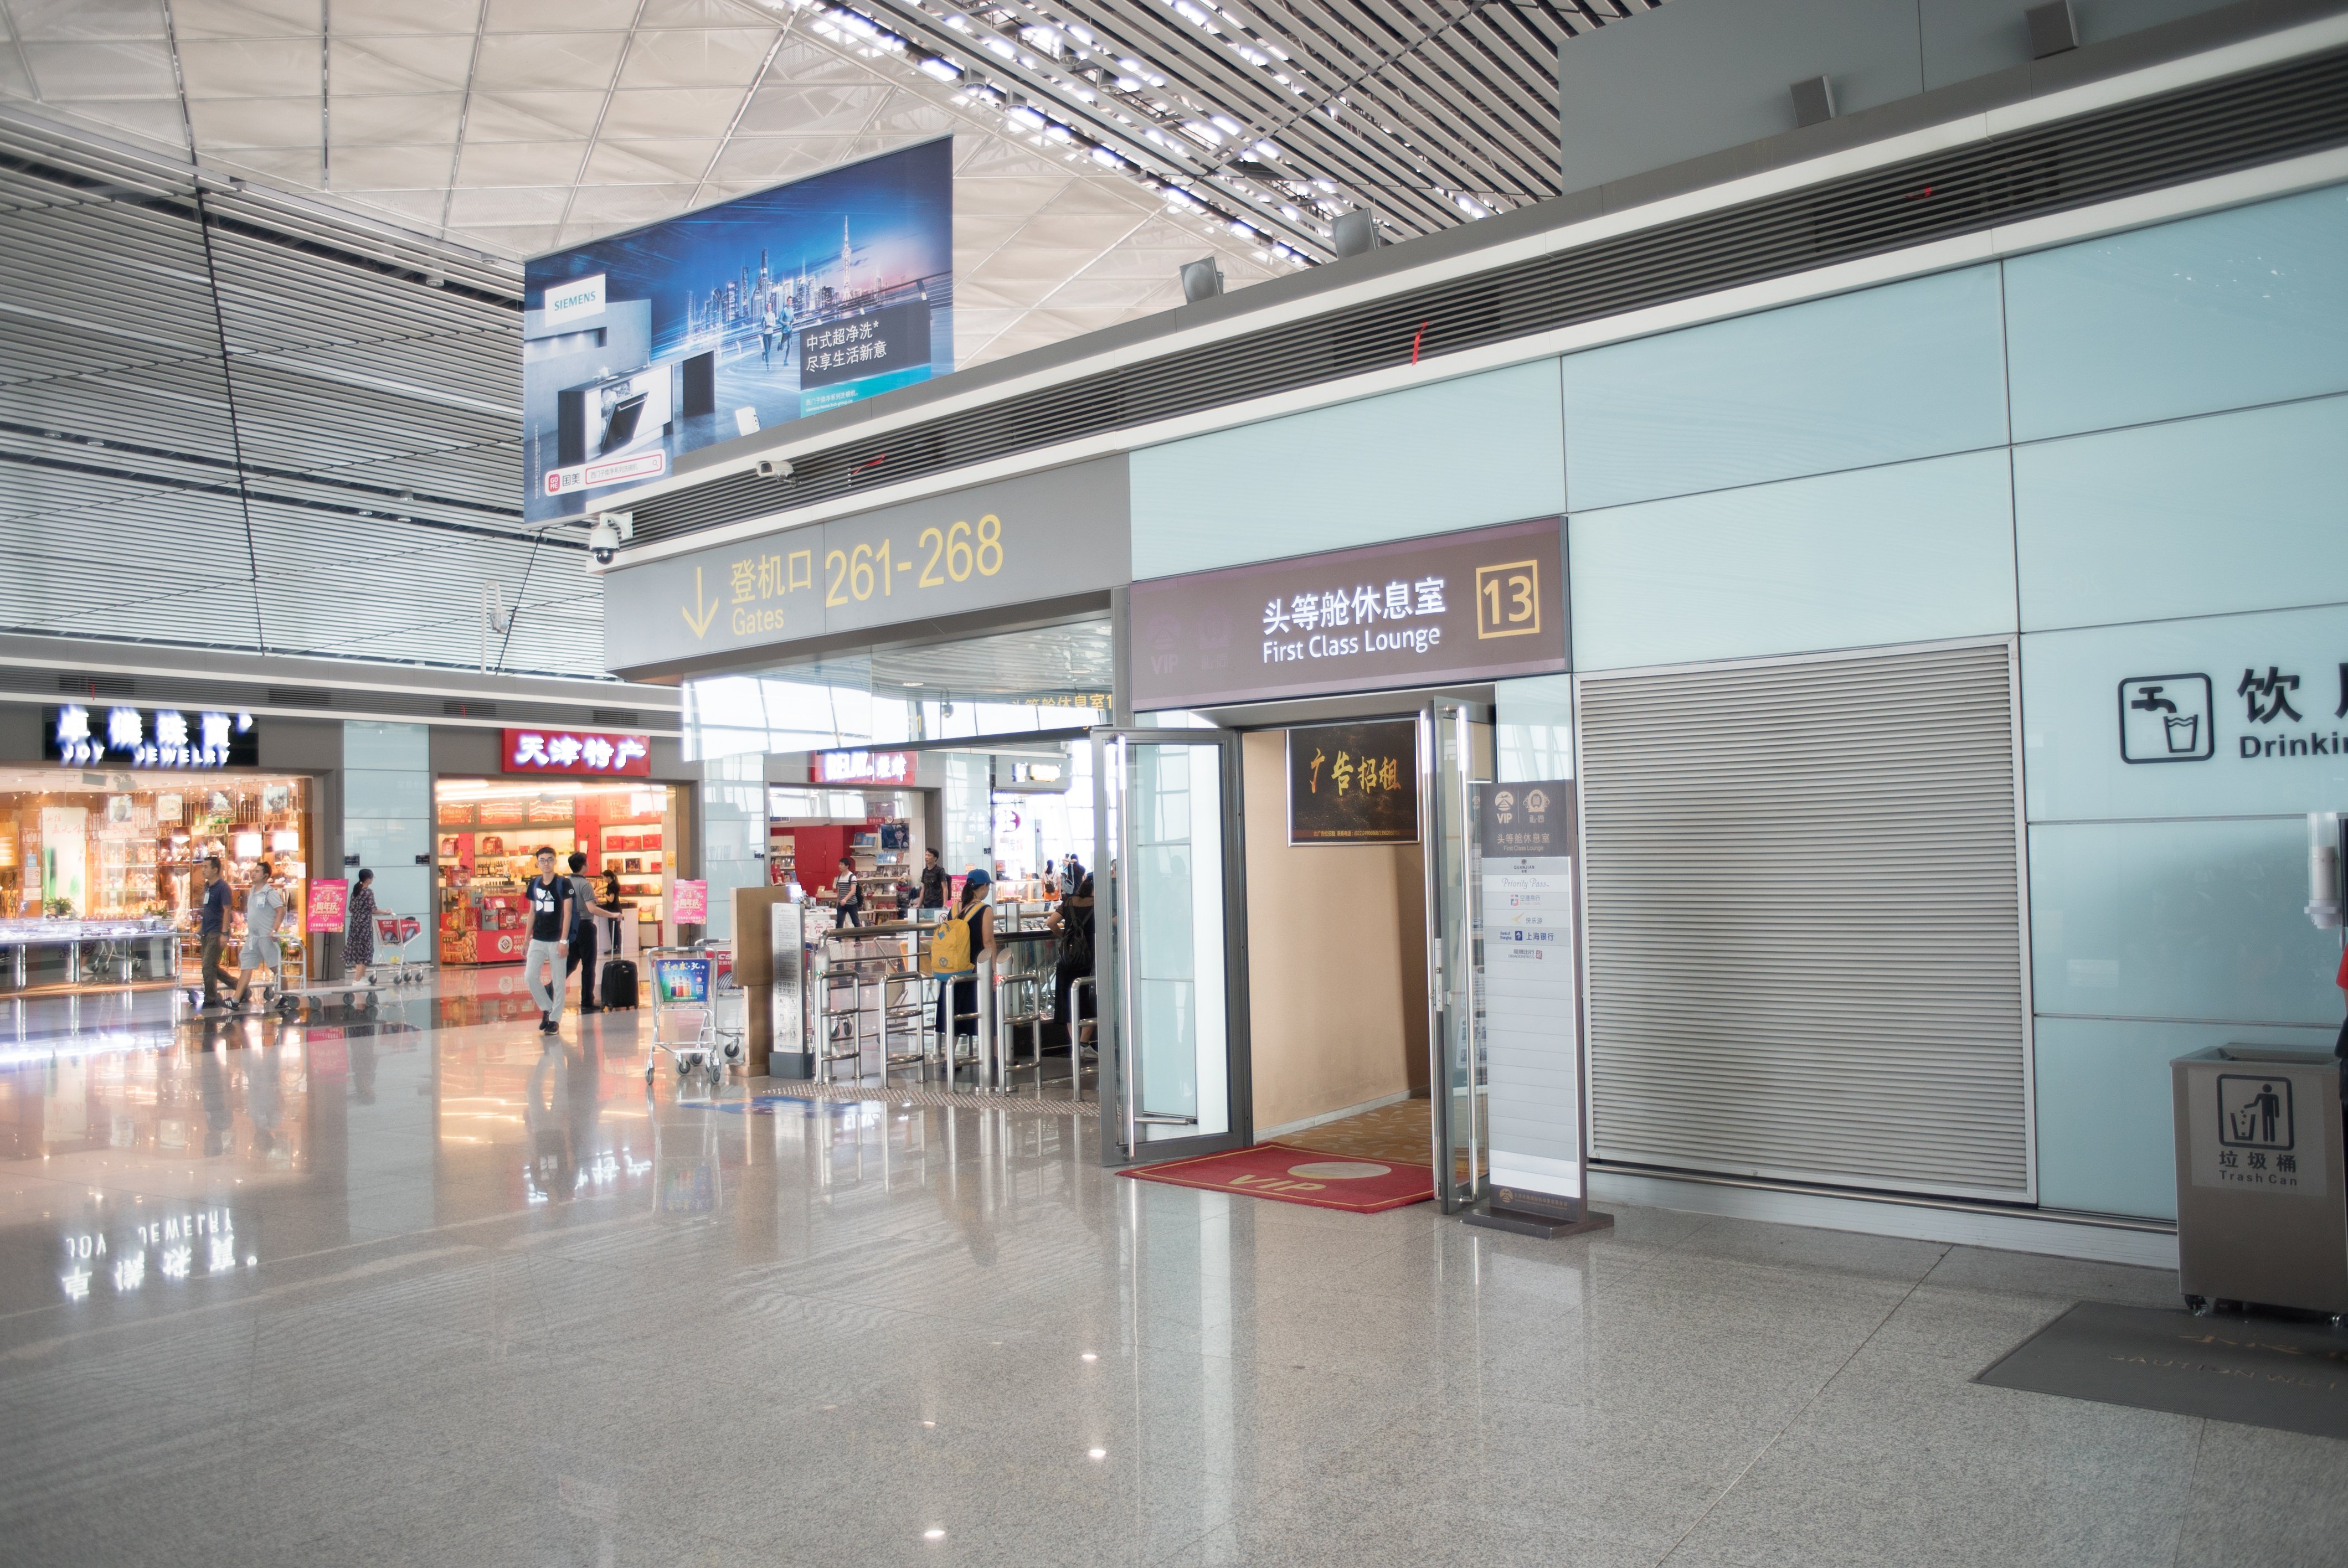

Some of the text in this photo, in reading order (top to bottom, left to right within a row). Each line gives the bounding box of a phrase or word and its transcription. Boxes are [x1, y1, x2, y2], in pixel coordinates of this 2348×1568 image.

[554, 291, 596, 311] SIEMENS
[806, 341, 887, 373] 尽享生活新意
[562, 473, 580, 486] 国美
[730, 514, 1003, 608] 登机口 261-268
[1263, 575, 1532, 635] 头等舱休息室 13
[733, 606, 784, 636] Gates
[1263, 626, 1440, 663] First Class Lounge
[1151, 654, 1178, 674] VIP
[2237, 663, 2348, 724] 饮
[62, 745, 230, 765] JOY JEWELRY
[516, 734, 646, 767] 天津特产
[2239, 731, 2348, 758] Drinki
[1310, 747, 1402, 796] 广告招租
[1497, 813, 1512, 824] VIP
[1497, 833, 1550, 844] 头等舱休息室
[1501, 878, 1547, 889] Priority Pass
[1526, 932, 1554, 941] 上海银行
[2218, 1150, 2297, 1174] 垃圾桶
[1227, 1174, 1327, 1193] VIP
[2219, 1169, 2298, 1187] Trash Can
